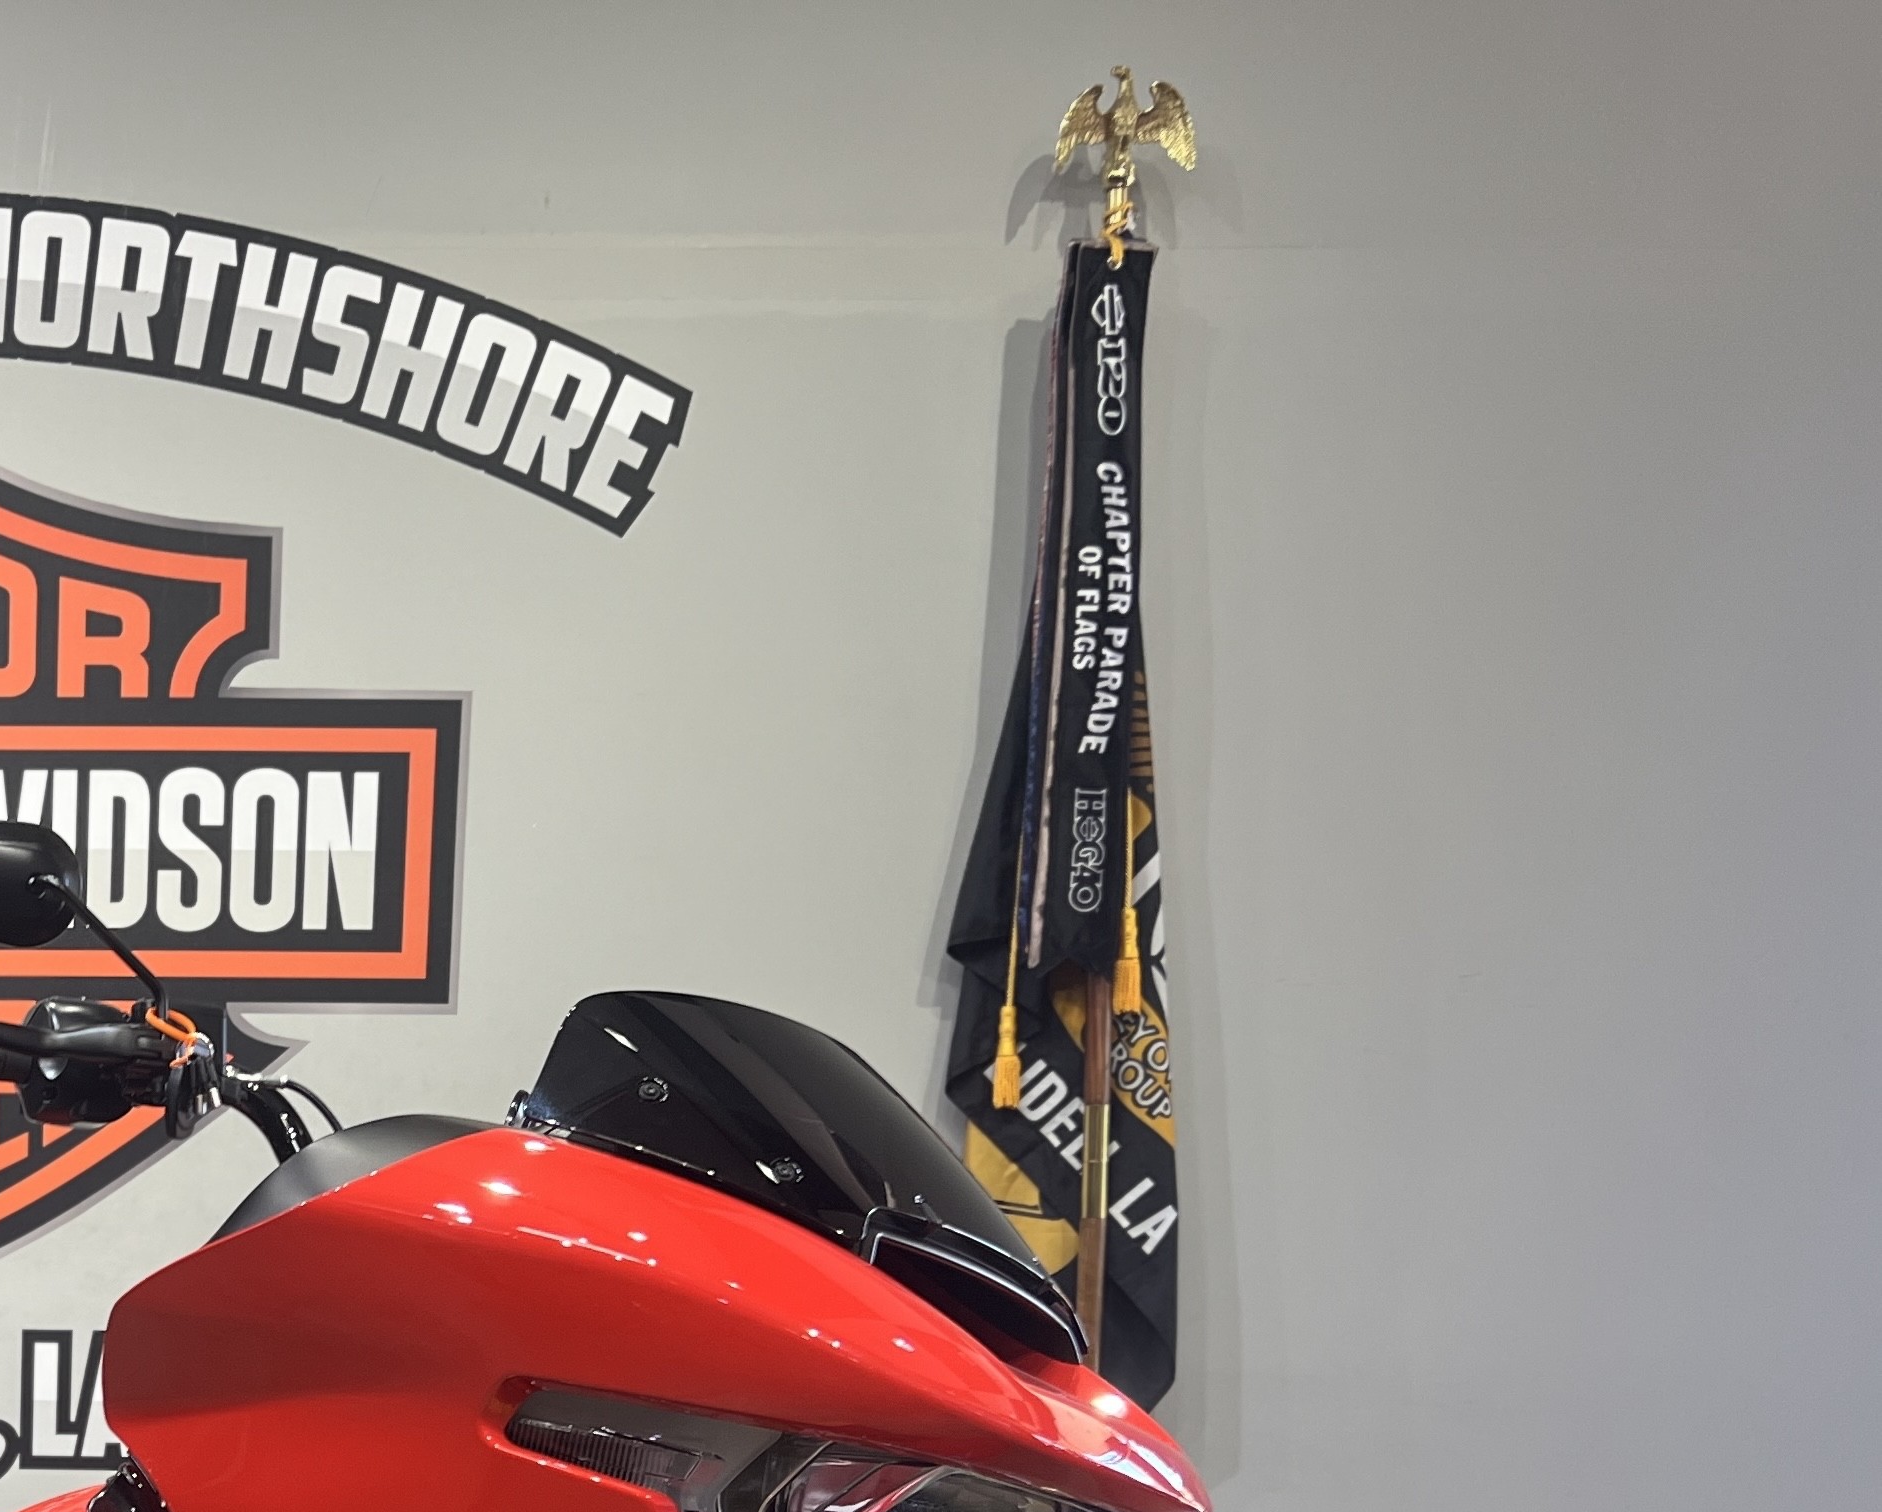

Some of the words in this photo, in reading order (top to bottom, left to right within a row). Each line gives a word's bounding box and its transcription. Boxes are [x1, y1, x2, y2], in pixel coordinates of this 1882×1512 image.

[1077, 544, 1103, 581] OF
[1095, 460, 1134, 617] CHAPTER
[1071, 588, 1101, 671] FLAGS
[1077, 627, 1130, 755] PARADE
[1110, 1041, 1172, 1117] ROUP
[1108, 1176, 1178, 1256] LA
